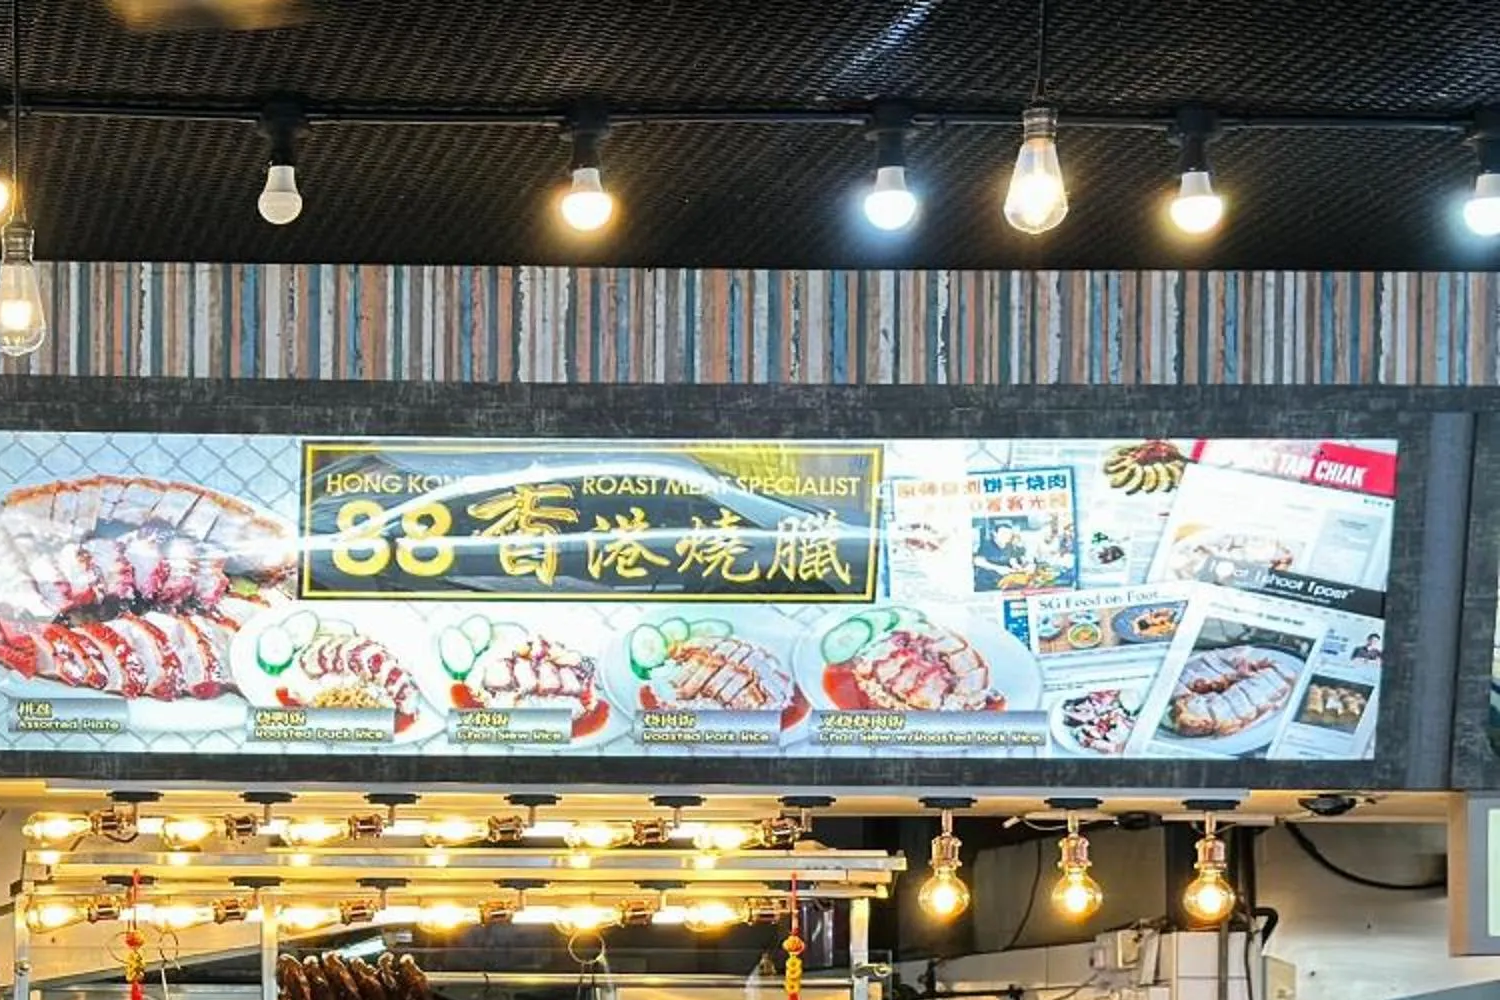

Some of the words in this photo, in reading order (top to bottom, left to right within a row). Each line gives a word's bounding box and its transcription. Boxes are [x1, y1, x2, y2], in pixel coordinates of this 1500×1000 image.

[326, 474, 402, 495] HONG
[407, 475, 486, 495] KON
[583, 475, 660, 496] ROAST
[737, 476, 860, 498] SPECIALIST
[1314, 458, 1368, 488] CHIAK
[331, 500, 455, 576] 88
